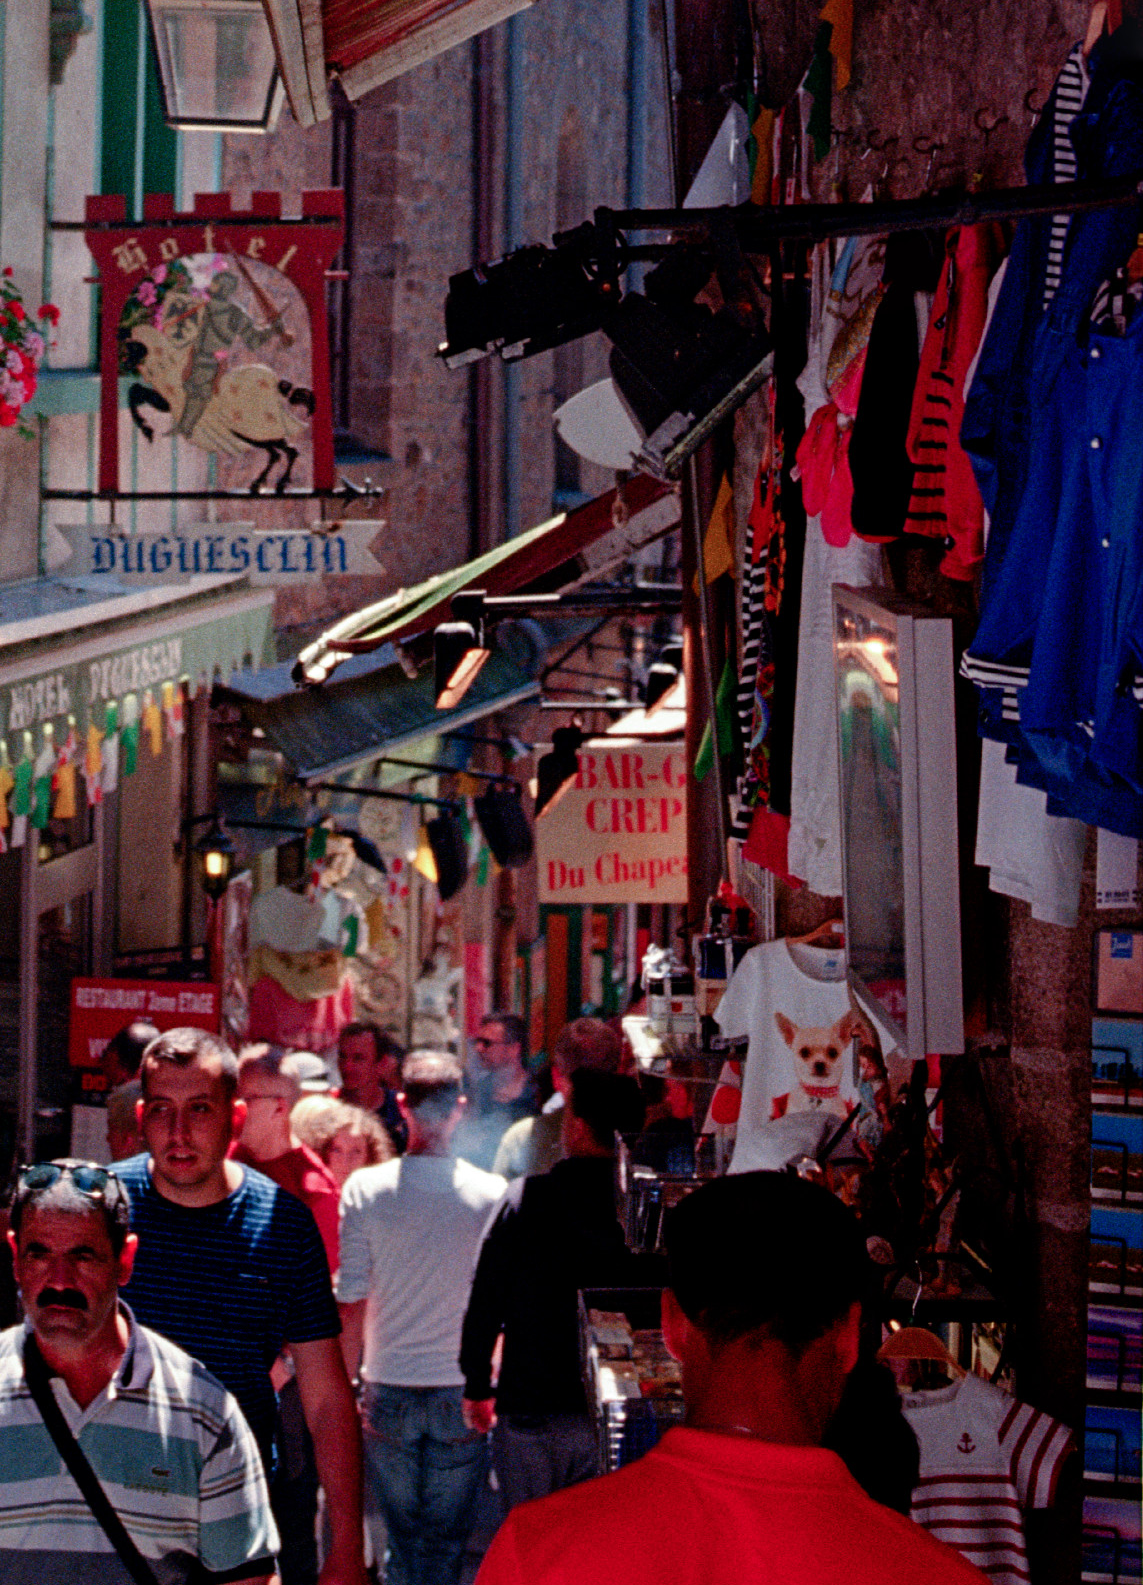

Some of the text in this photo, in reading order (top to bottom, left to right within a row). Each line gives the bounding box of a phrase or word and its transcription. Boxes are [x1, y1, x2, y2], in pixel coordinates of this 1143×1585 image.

[90, 535, 349, 576] DUGUESCLIN
[574, 752, 687, 789] BAR-G
[585, 797, 683, 833] CREP
[548, 860, 584, 890] Du
